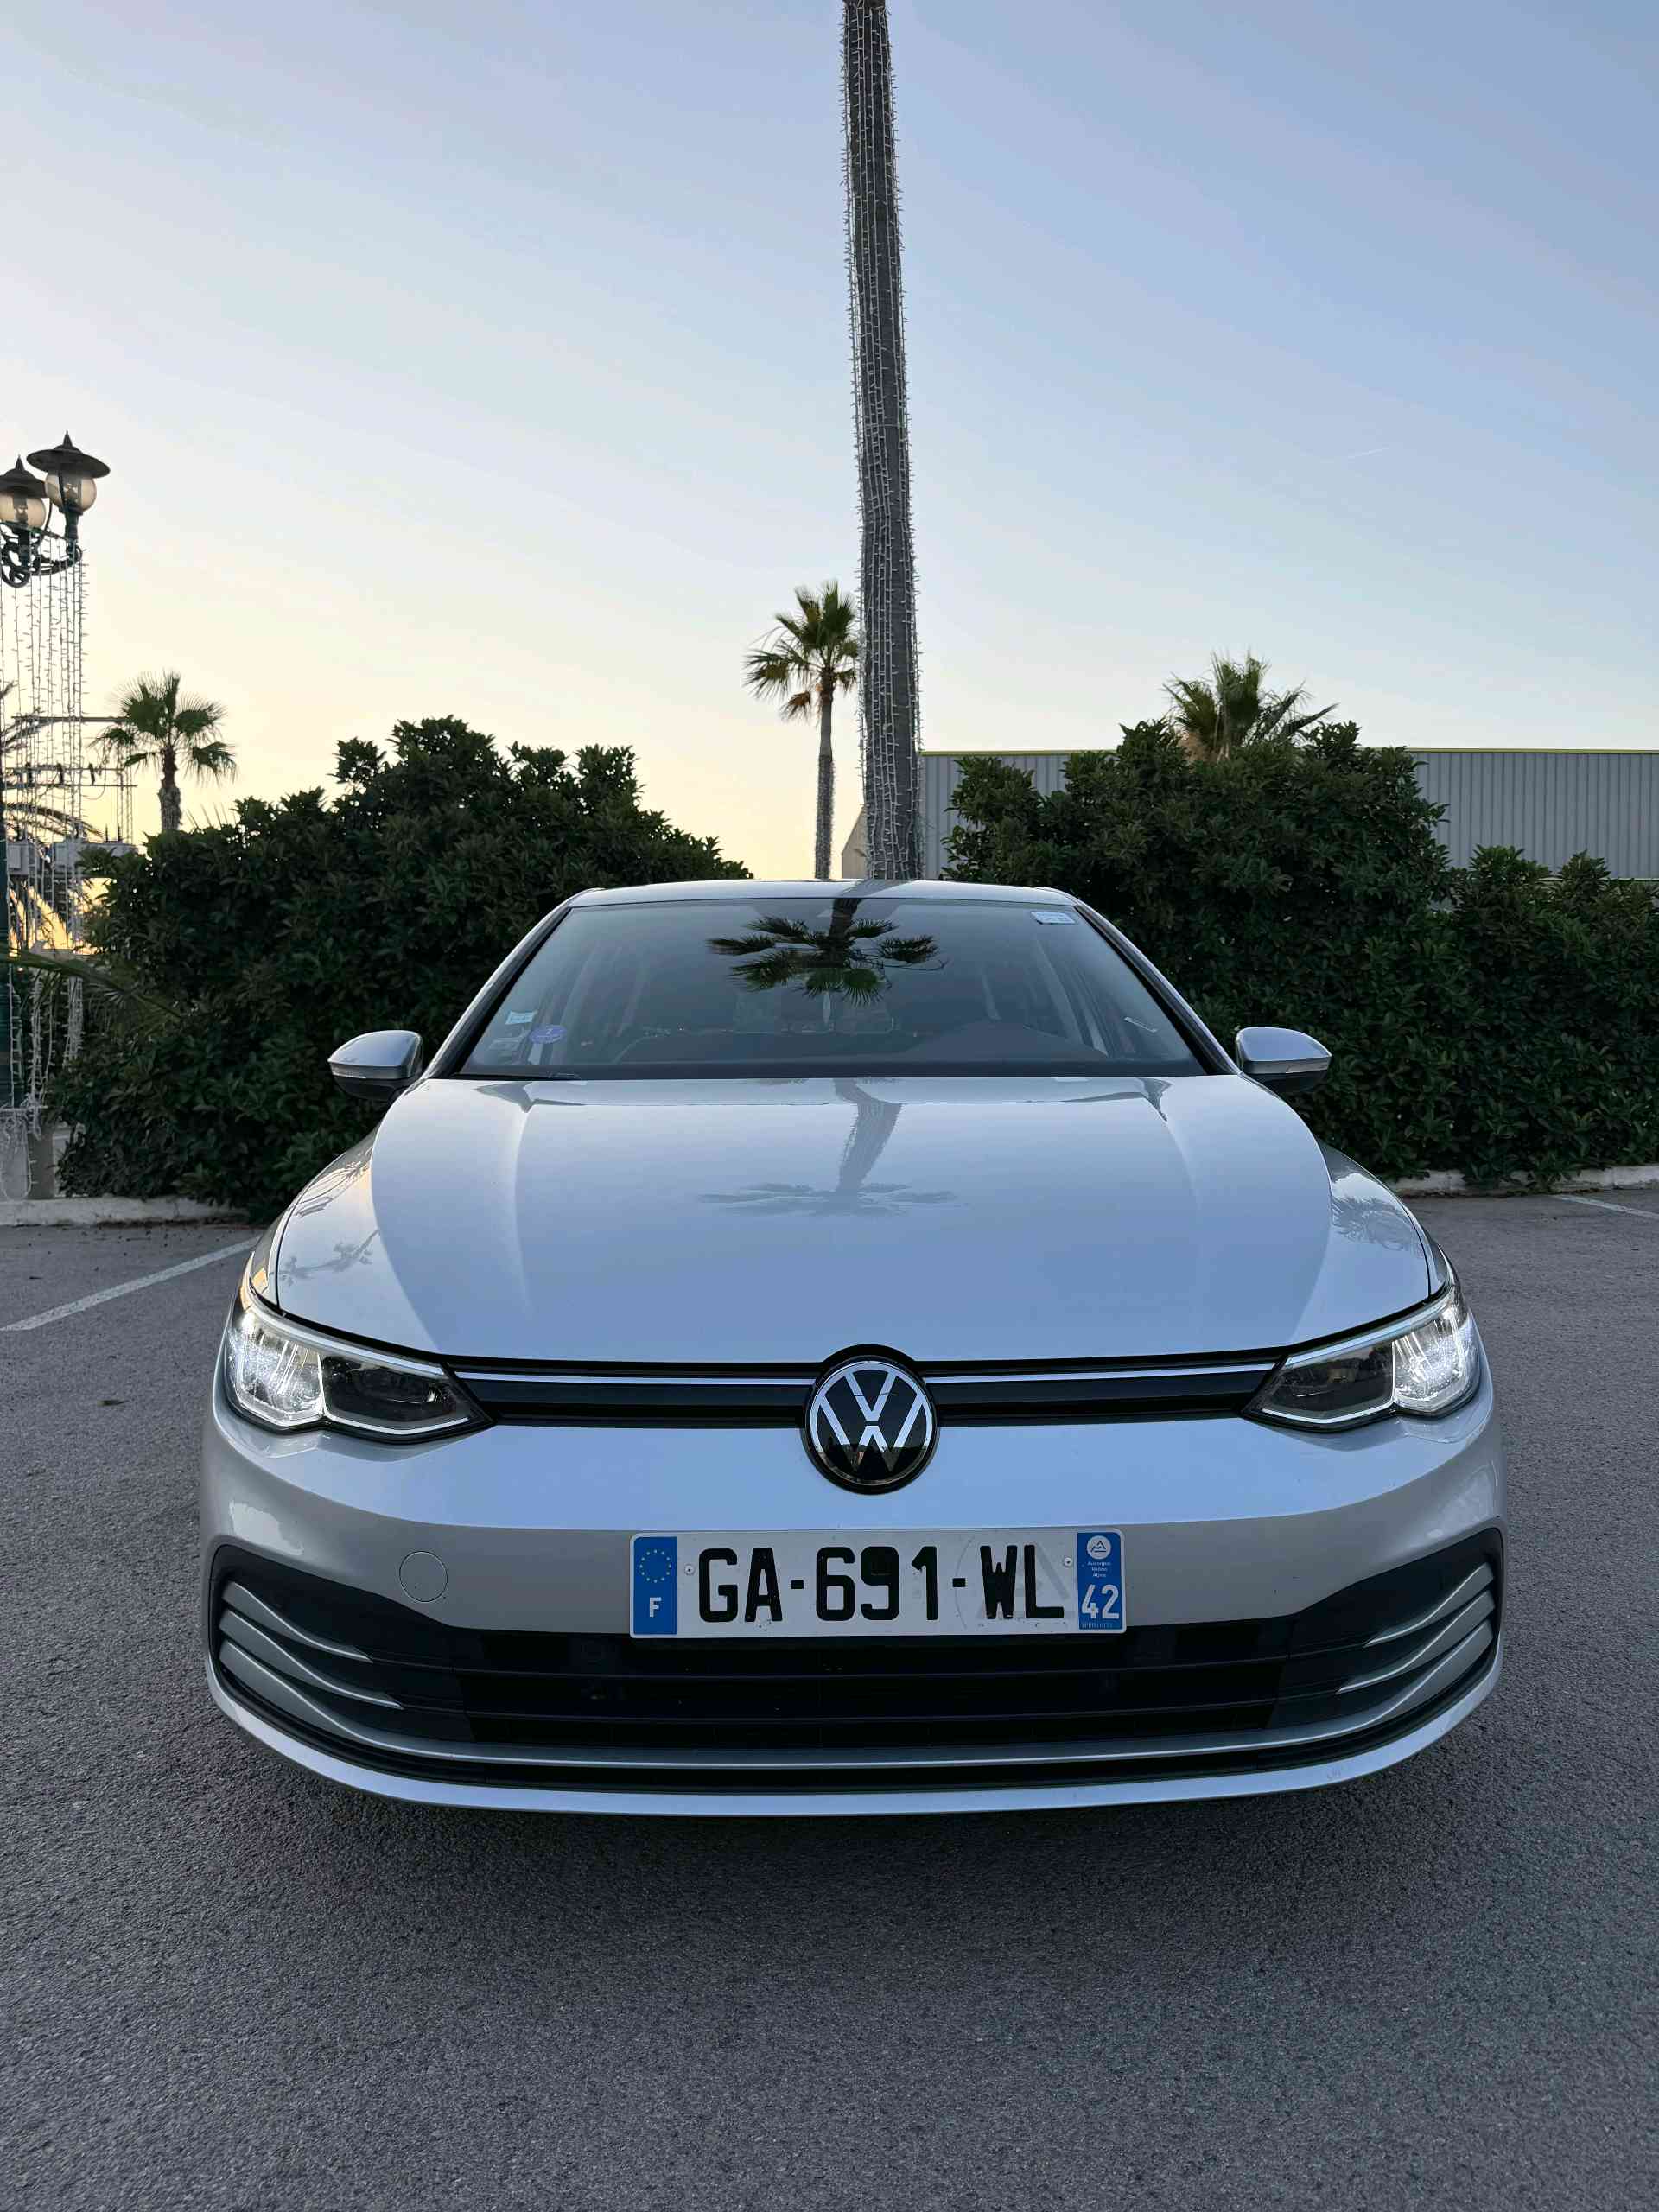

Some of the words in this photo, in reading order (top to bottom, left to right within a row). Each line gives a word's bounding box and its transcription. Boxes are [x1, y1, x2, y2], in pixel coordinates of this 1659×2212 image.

[698, 1544, 1065, 1623] GA-691-WL
[649, 1597, 662, 1618] F
[1081, 1584, 1120, 1619] 42
